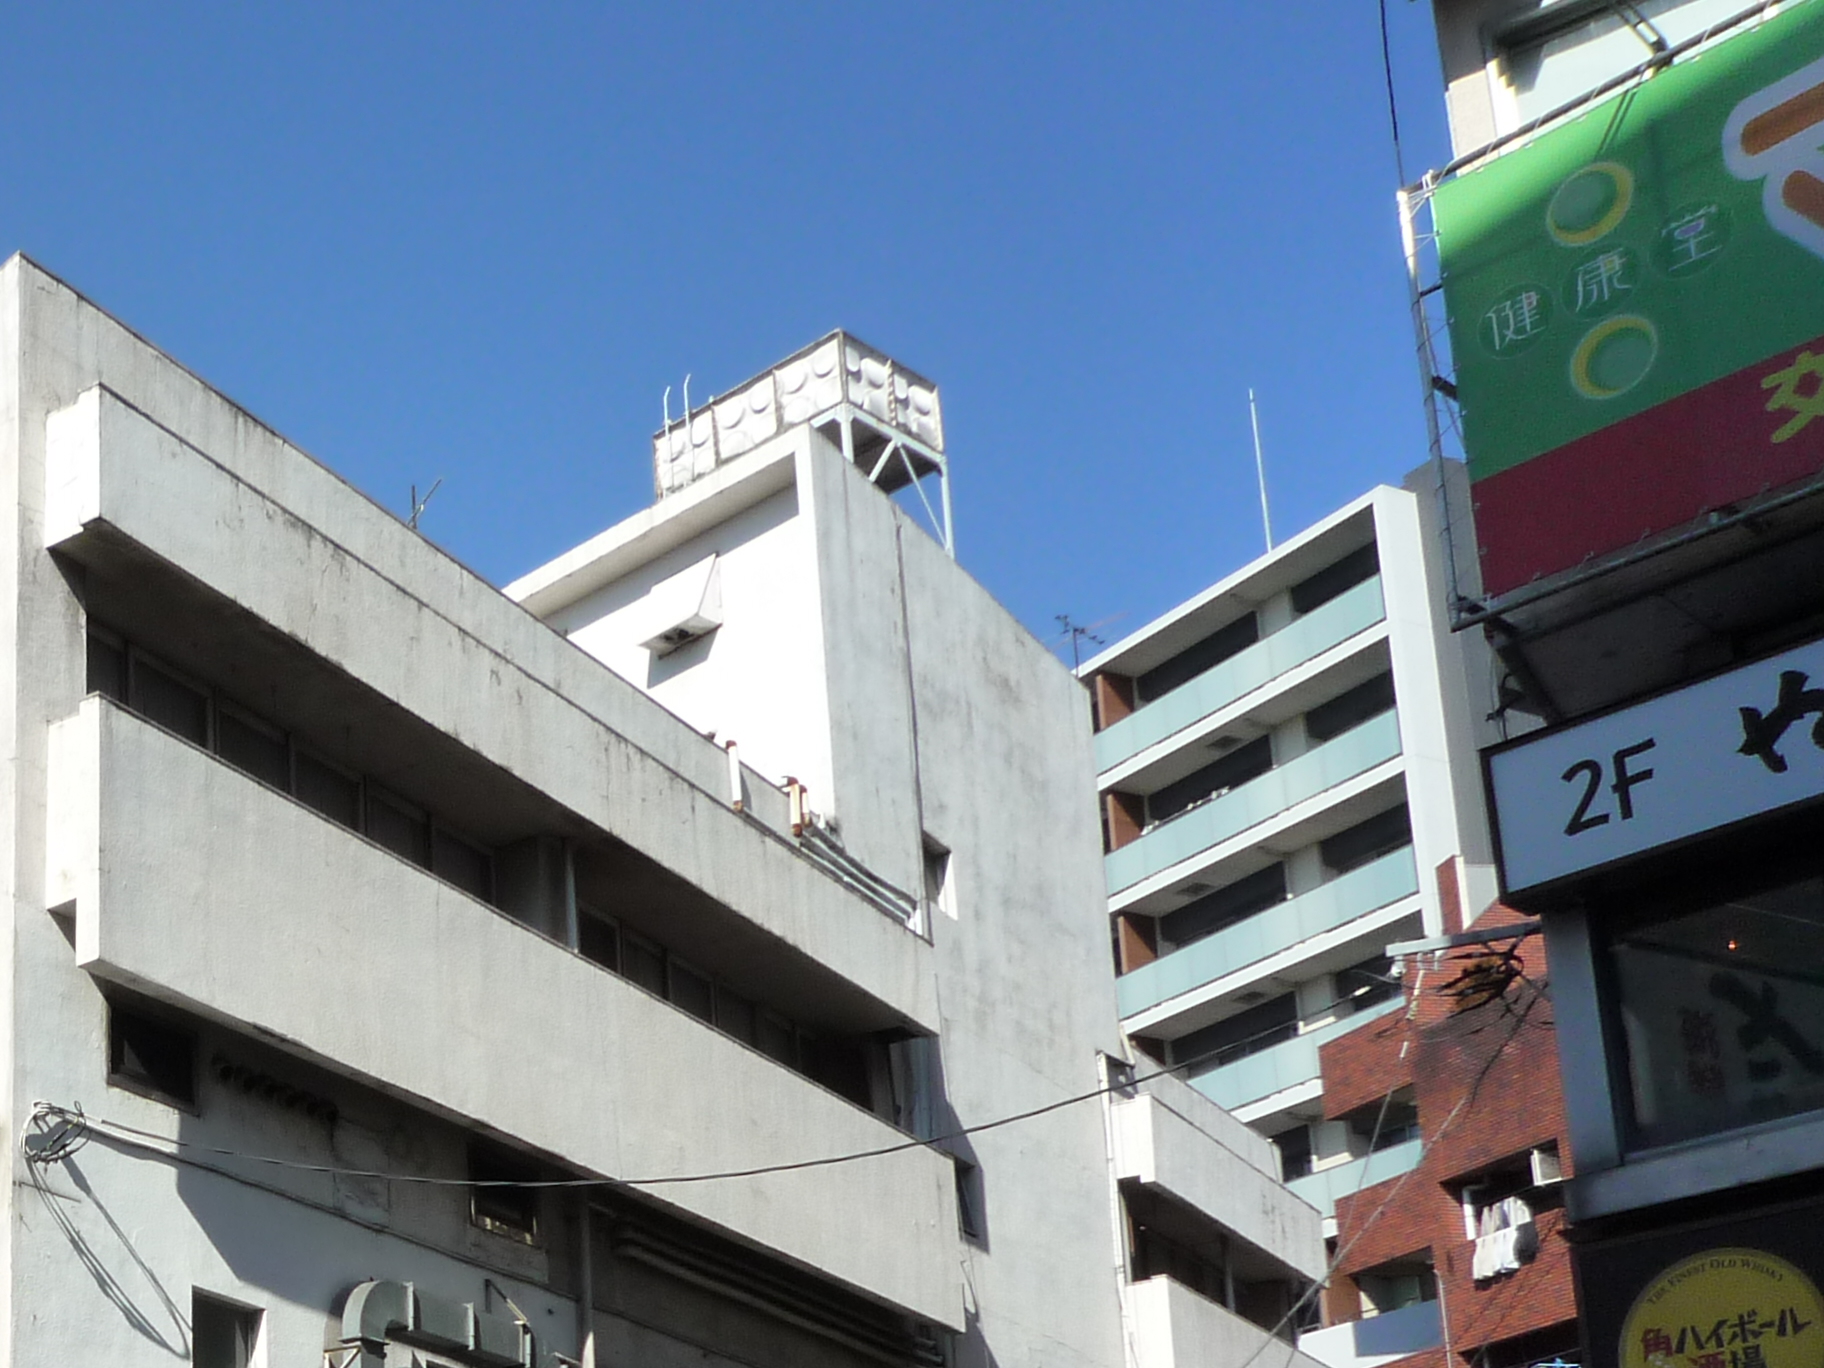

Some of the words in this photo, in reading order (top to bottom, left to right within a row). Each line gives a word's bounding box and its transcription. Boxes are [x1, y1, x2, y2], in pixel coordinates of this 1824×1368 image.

[1561, 737, 1656, 838] 2F
[1640, 1306, 1813, 1364] 角ハイボール
